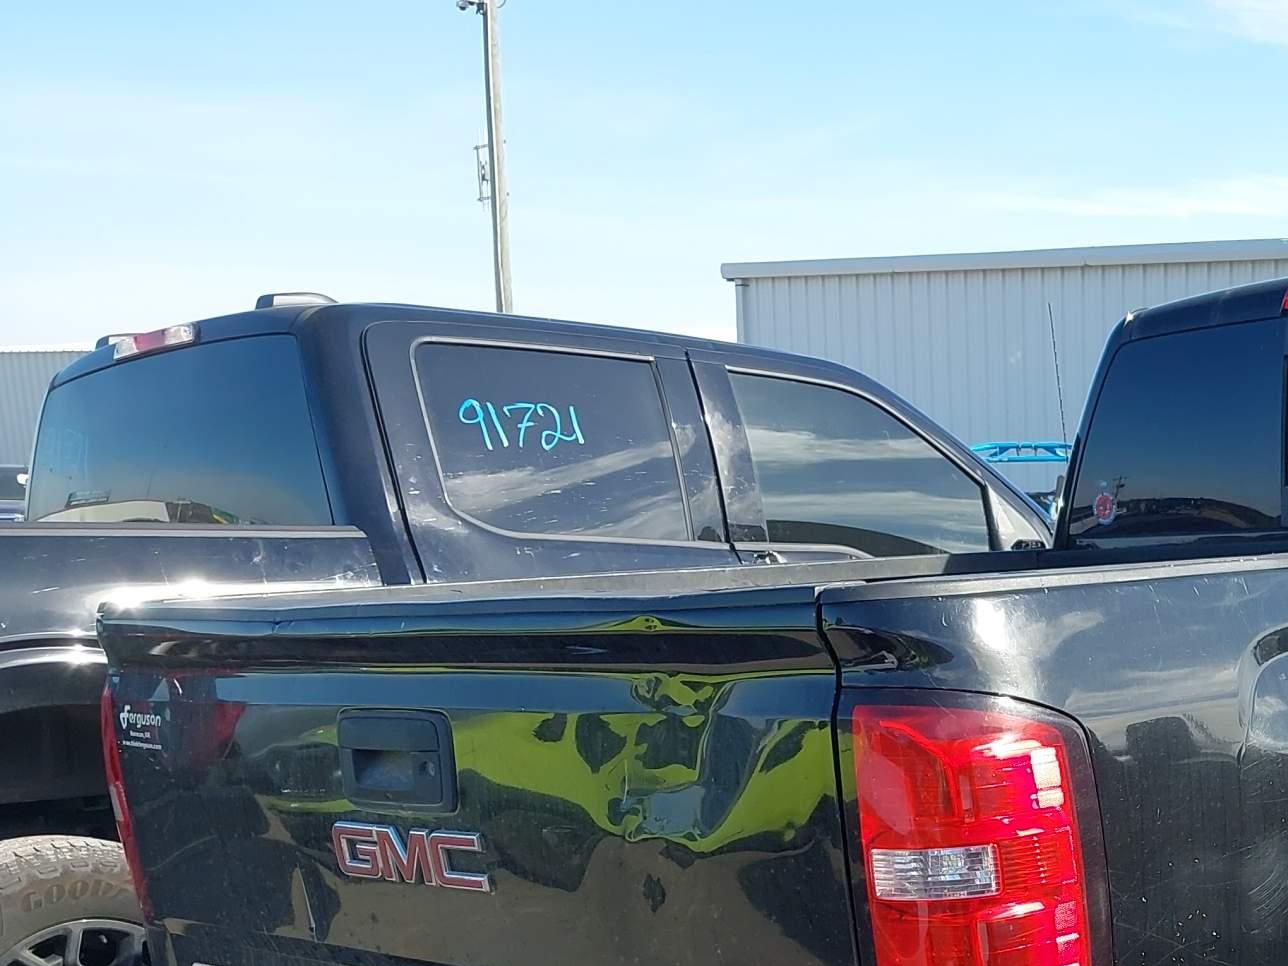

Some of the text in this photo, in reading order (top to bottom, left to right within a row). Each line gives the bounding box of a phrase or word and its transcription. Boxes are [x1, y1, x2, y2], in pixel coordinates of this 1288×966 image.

[459, 398, 585, 451] 91721
[119, 704, 162, 730] Ferguson
[331, 820, 491, 893] GMC
